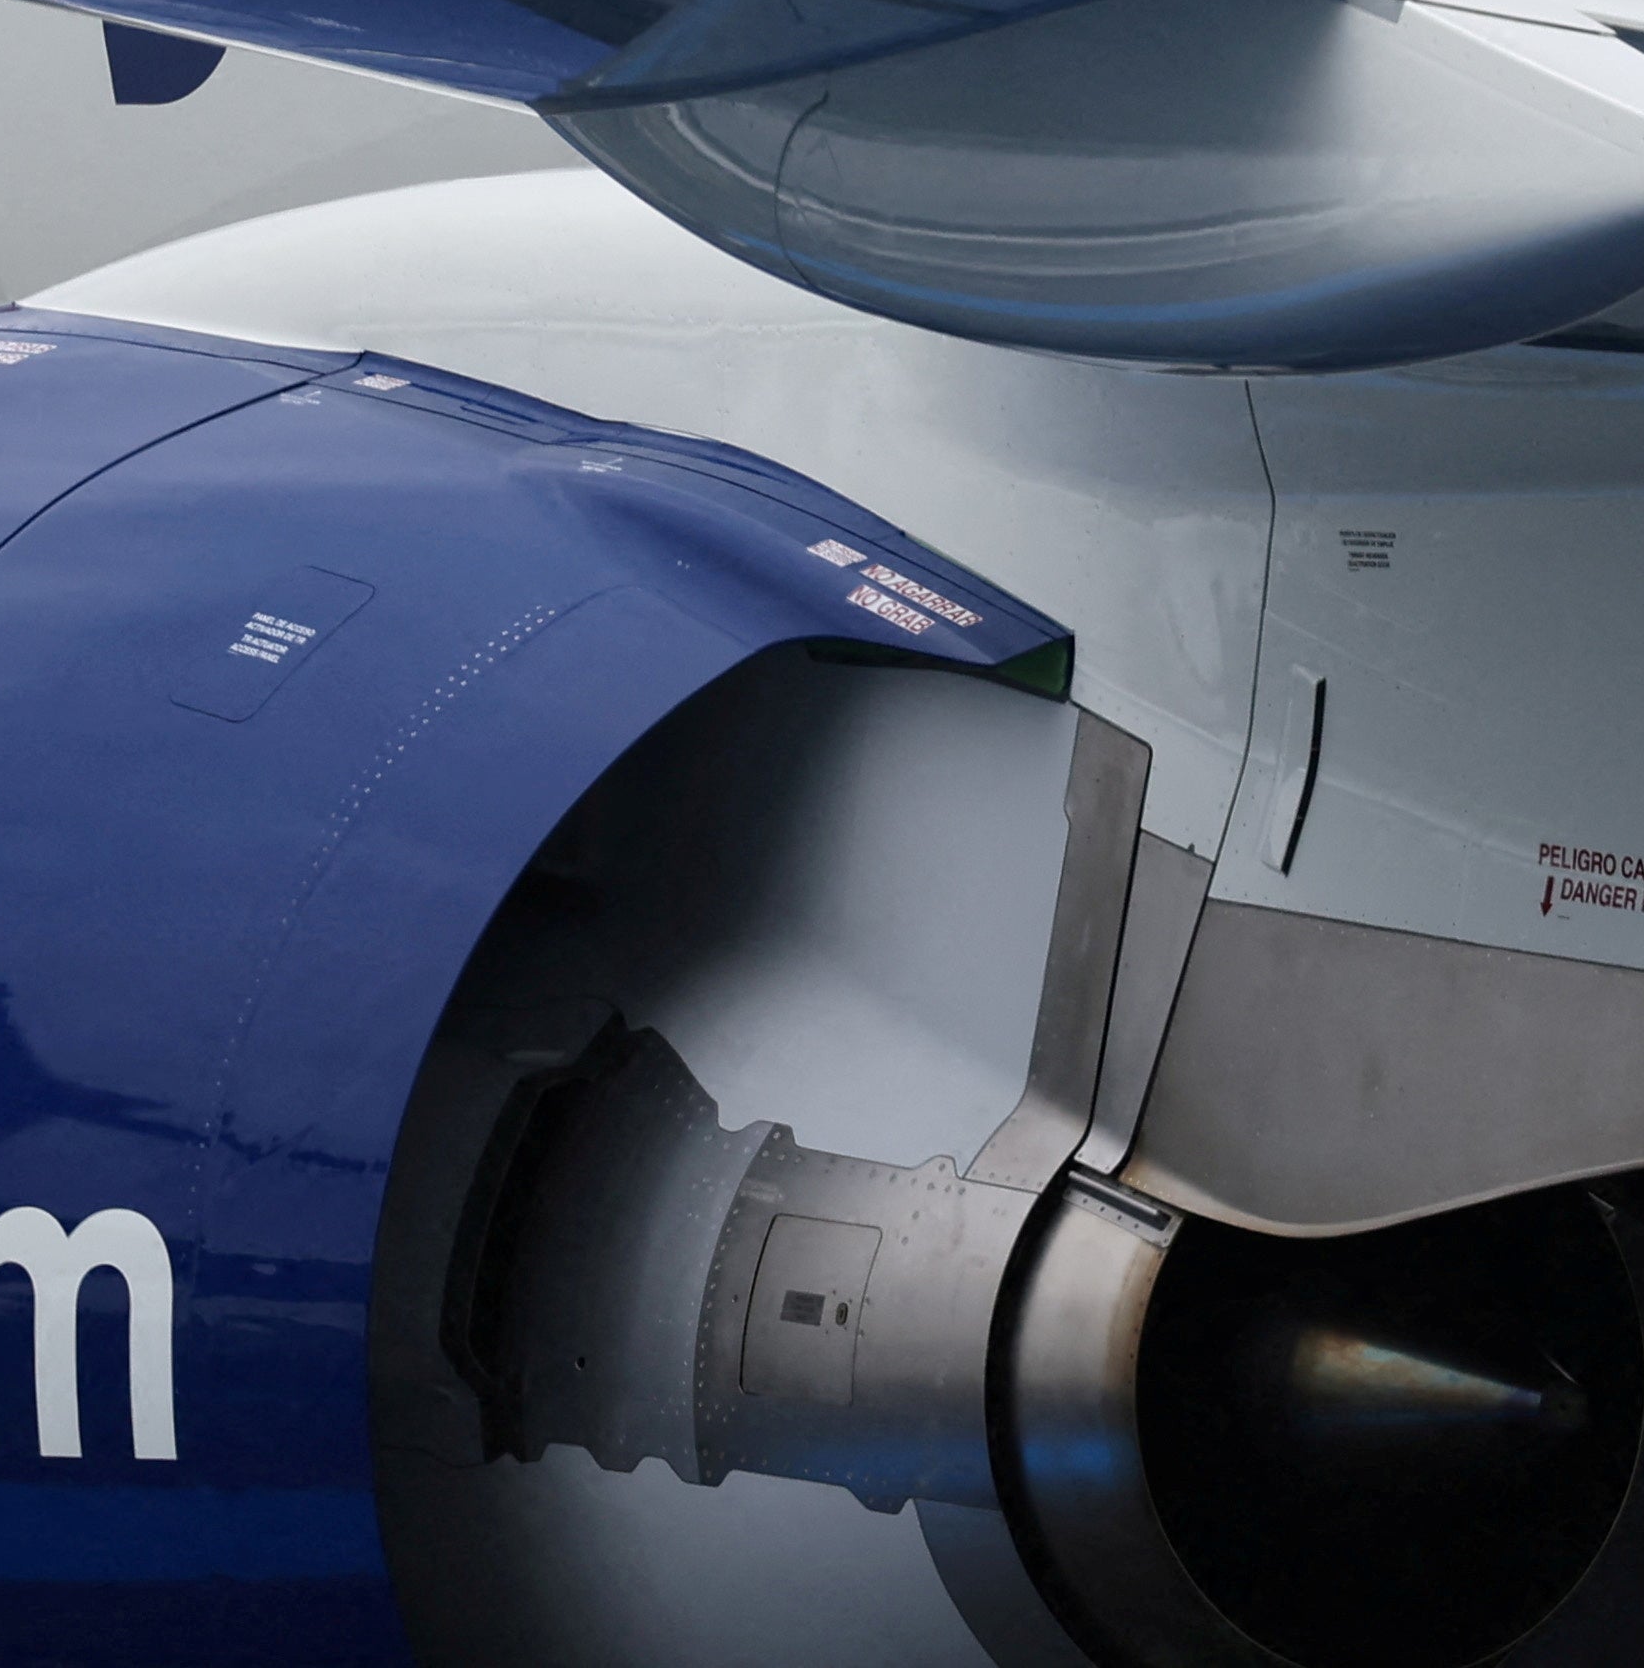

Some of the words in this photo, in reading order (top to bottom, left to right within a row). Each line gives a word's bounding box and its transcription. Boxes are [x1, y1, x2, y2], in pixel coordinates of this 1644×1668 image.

[849, 586, 881, 607] NO
[877, 601, 932, 632] GRAB
[867, 564, 895, 582] NO
[890, 581, 982, 627] AGARRAR
[1538, 843, 1617, 876] PELIGRO
[1560, 878, 1638, 911] DANGER
